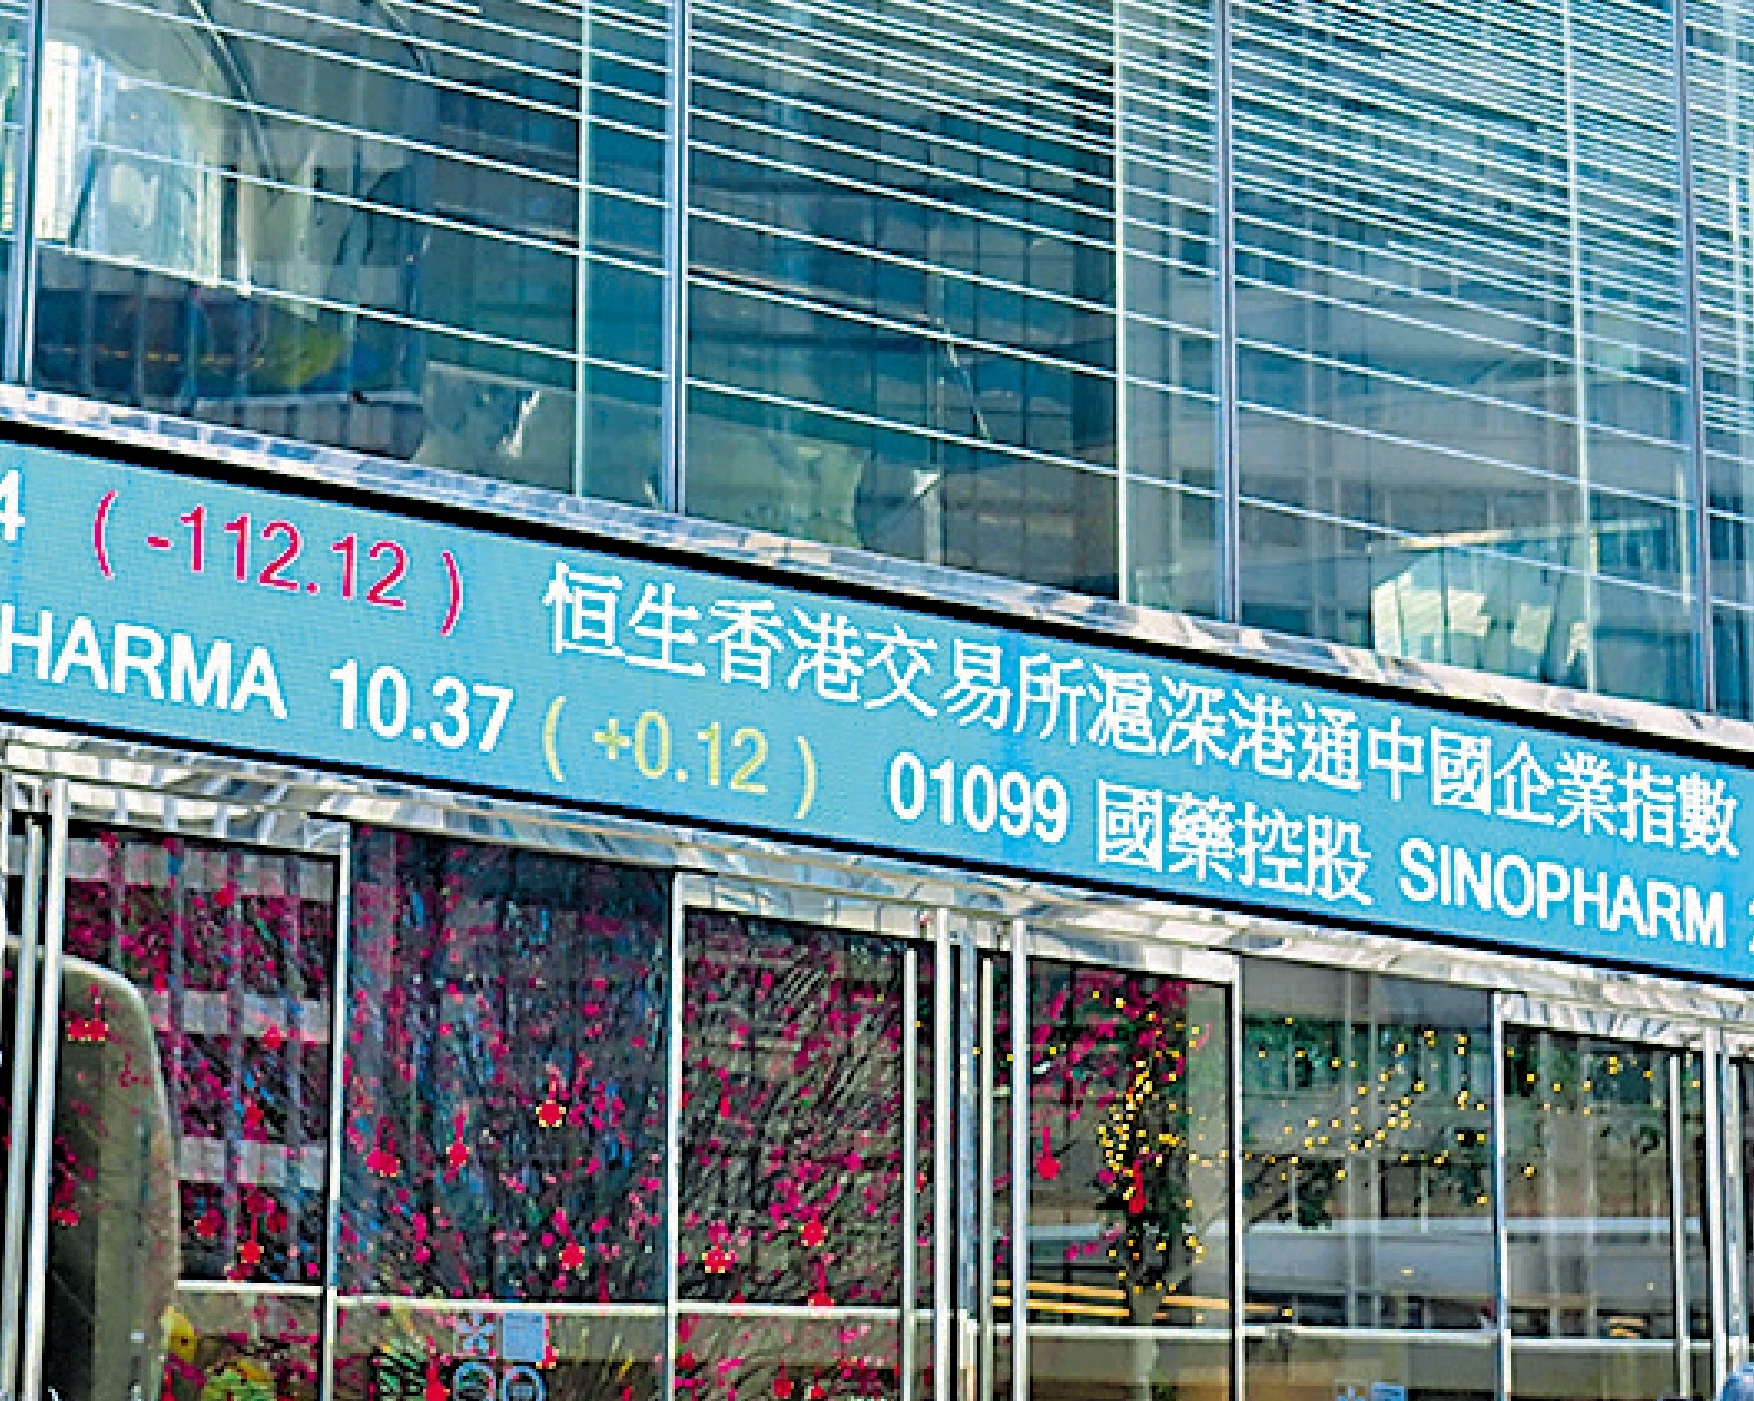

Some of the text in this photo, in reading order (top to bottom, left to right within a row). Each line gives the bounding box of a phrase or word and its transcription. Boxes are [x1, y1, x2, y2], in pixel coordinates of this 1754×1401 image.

[330, 659, 515, 754] 10.37
[890, 751, 1067, 844] 01099
[1096, 777, 1372, 907] 國藥控股
[1399, 836, 1726, 949] SINOPHARM
